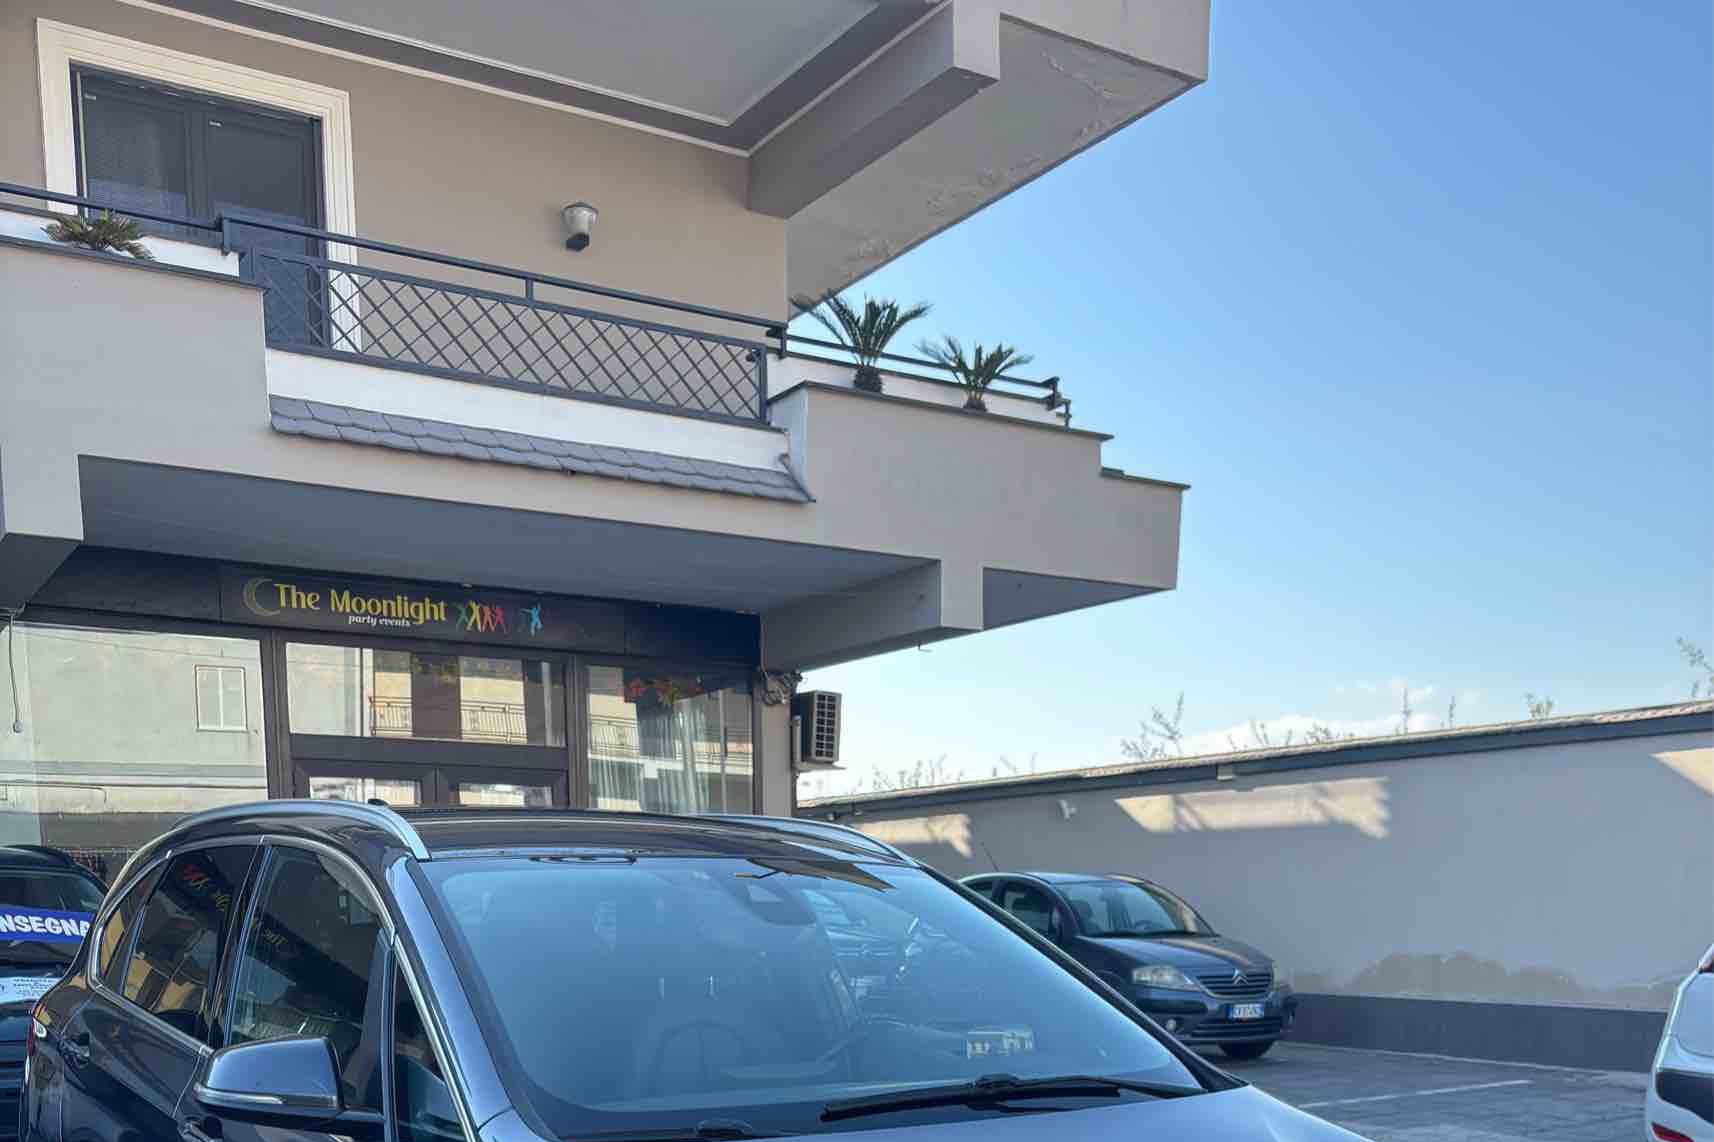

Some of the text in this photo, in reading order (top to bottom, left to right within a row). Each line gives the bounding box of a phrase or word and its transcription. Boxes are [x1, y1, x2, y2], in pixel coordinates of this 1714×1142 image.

[275, 584, 447, 624] The Moonlight
[348, 614, 411, 628] party events
